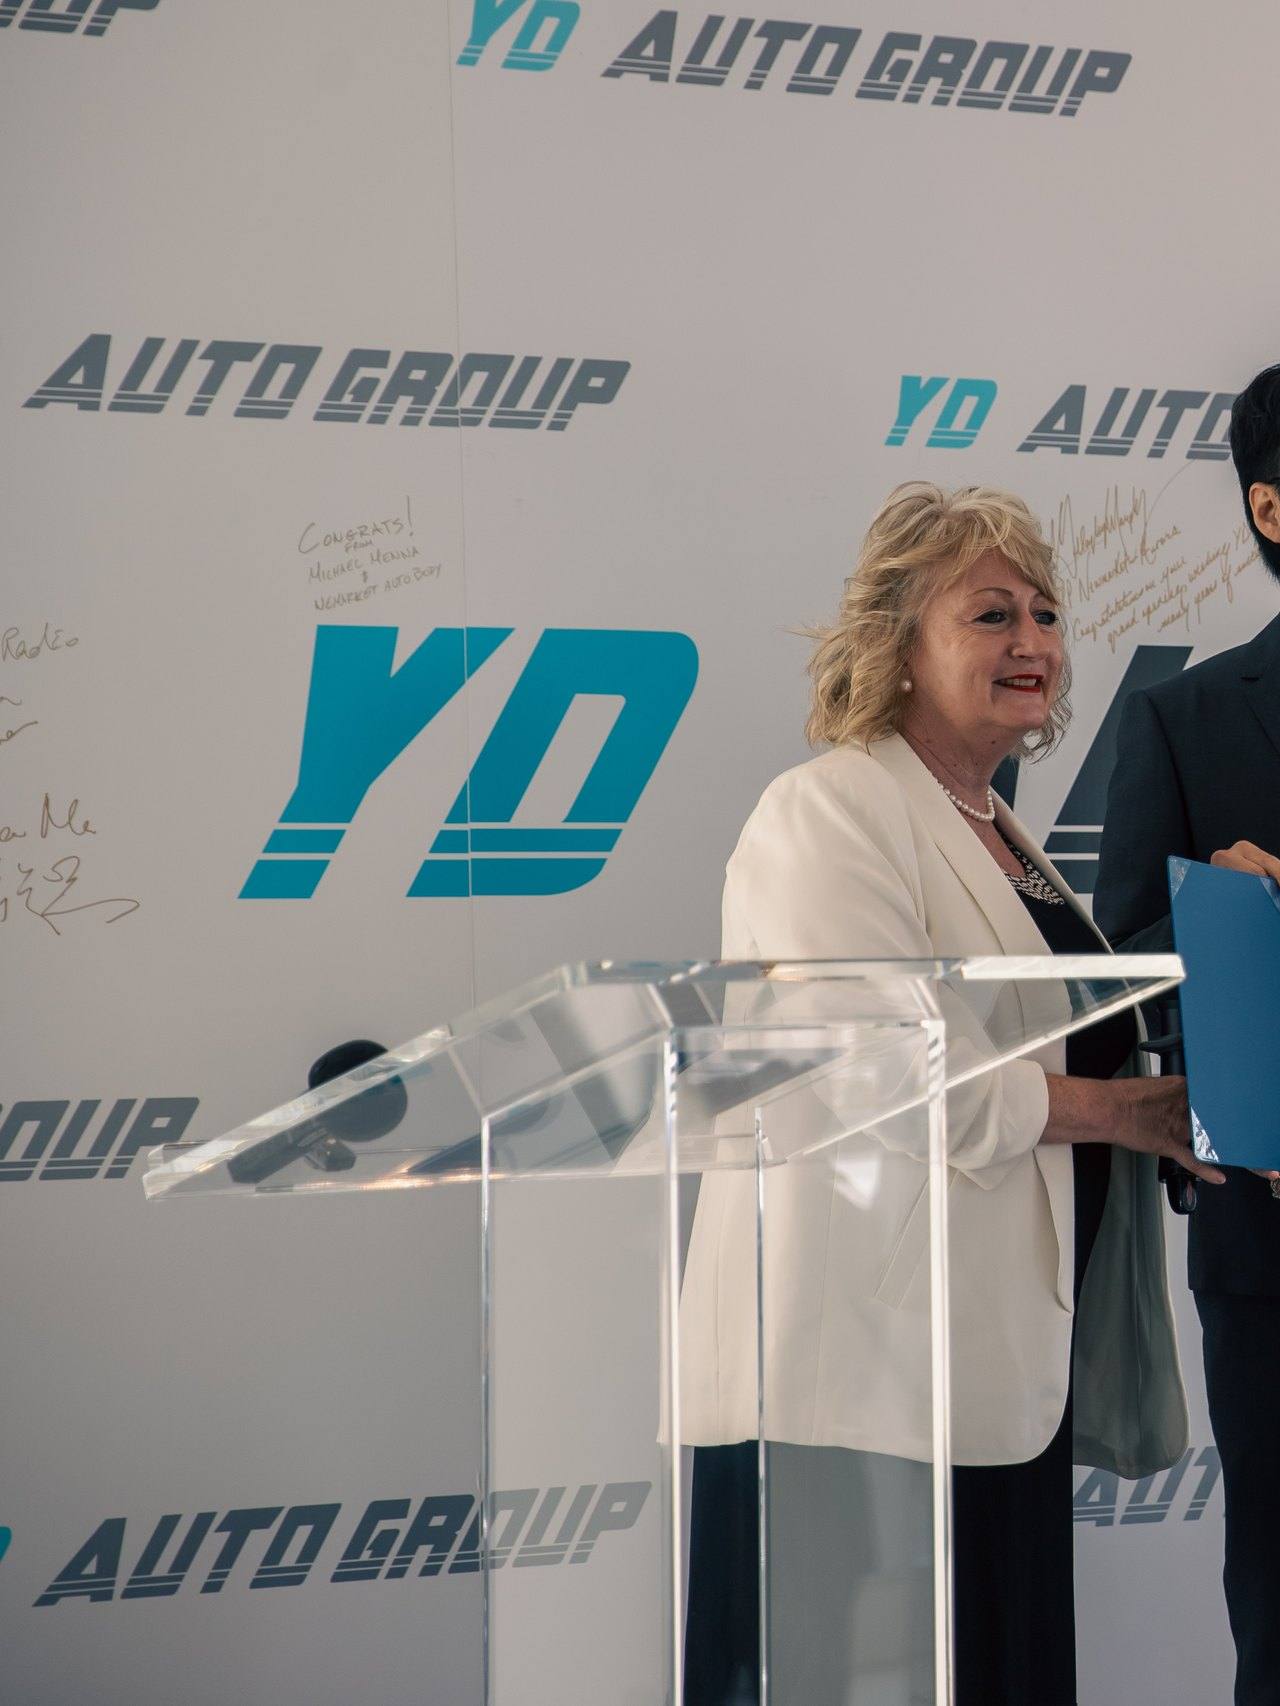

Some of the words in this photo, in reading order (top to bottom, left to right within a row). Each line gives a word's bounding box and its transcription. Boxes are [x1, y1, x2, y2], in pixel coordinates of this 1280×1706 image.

[457, 0, 581, 72] YD
[600, 9, 862, 96] AUTO
[854, 31, 1133, 117] GROUP
[21, 333, 323, 420] AUTO
[312, 348, 632, 432] GROUP
[884, 375, 998, 449] YD
[238, 624, 700, 900] YD
[0, 1096, 201, 1183] OUP
[31, 1502, 342, 1608] AUTO
[330, 1480, 653, 1584] GROUP
